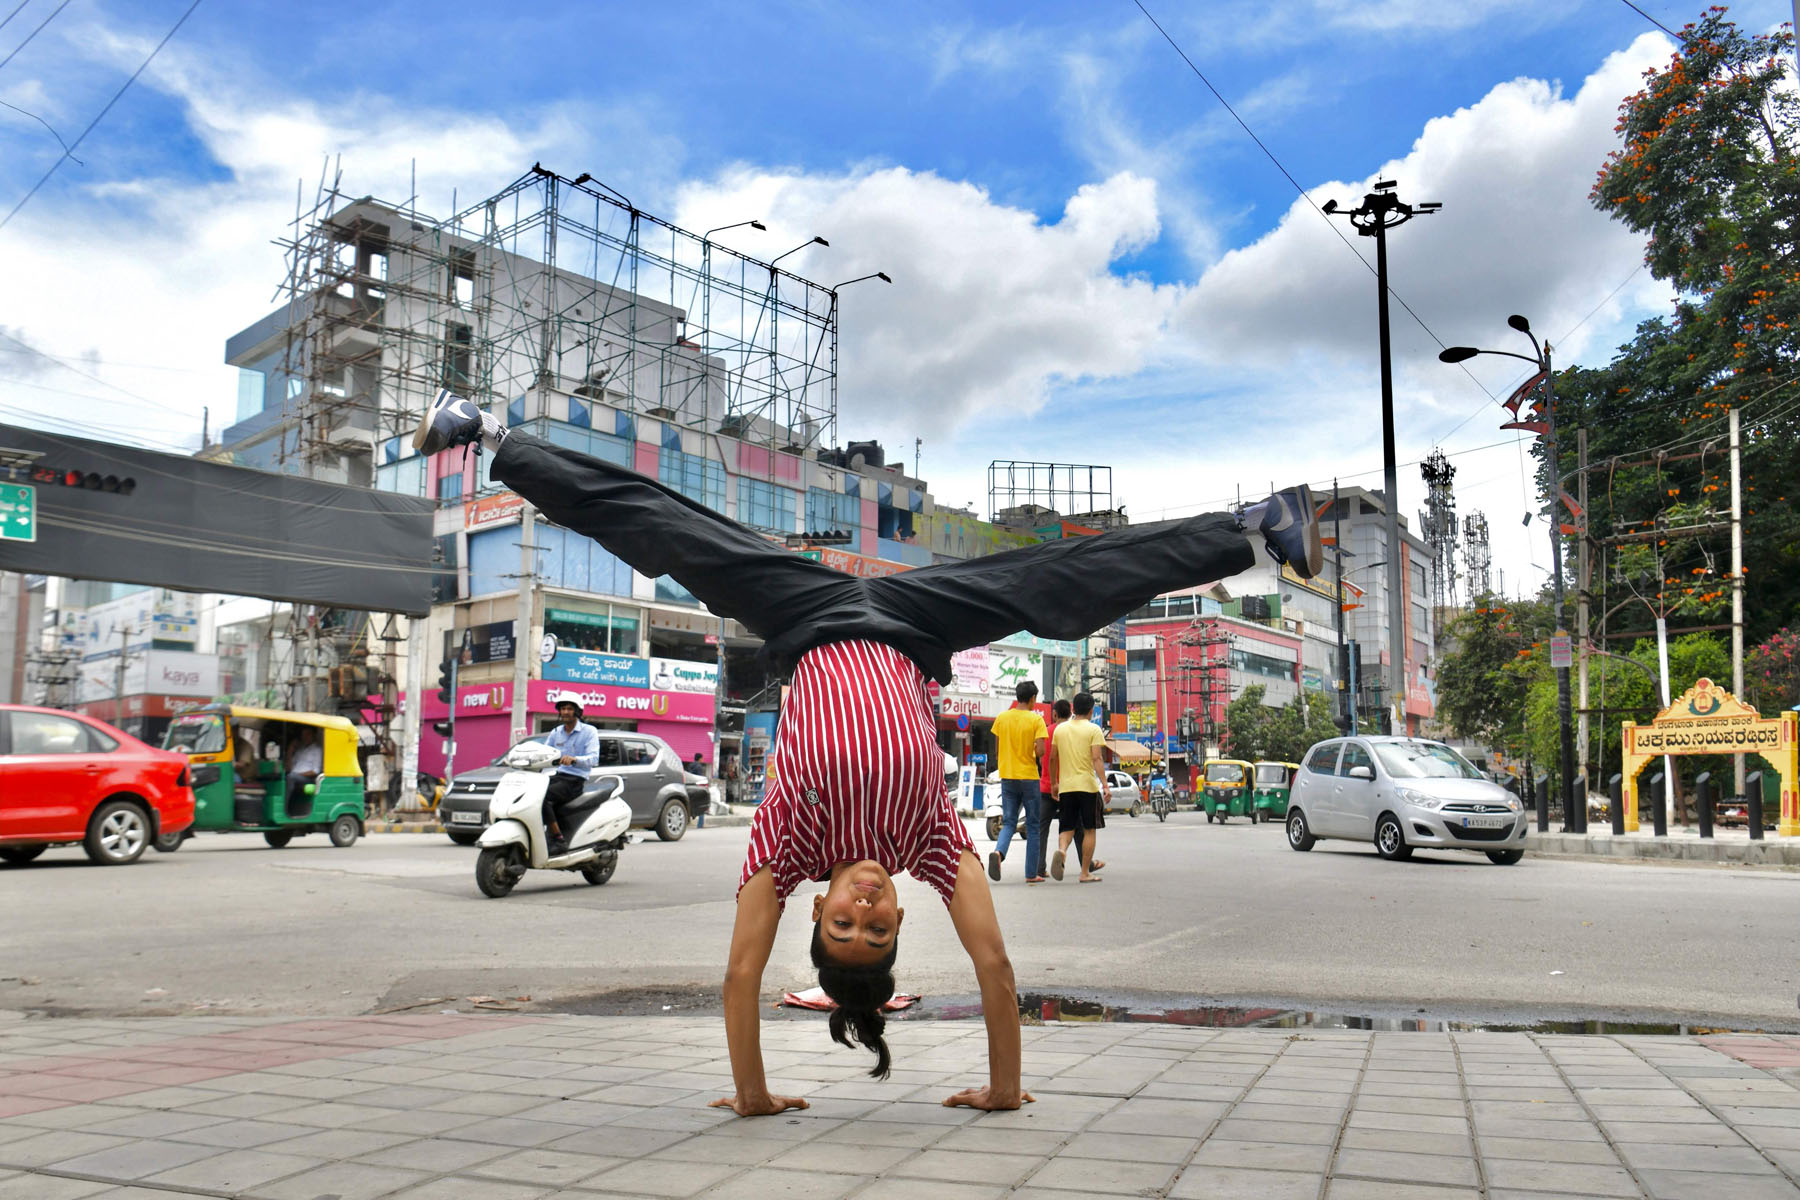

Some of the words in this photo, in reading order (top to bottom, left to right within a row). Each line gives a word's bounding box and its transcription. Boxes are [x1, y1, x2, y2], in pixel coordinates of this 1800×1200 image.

[162, 665, 200, 685] kaya
[567, 668, 581, 678] The
[583, 669, 599, 680] cafe
[600, 671, 618, 682] with
[626, 673, 646, 684] heart
[673, 667, 702, 680] Cuppa
[703, 669, 718, 683] Joy
[953, 699, 982, 714] airtel
